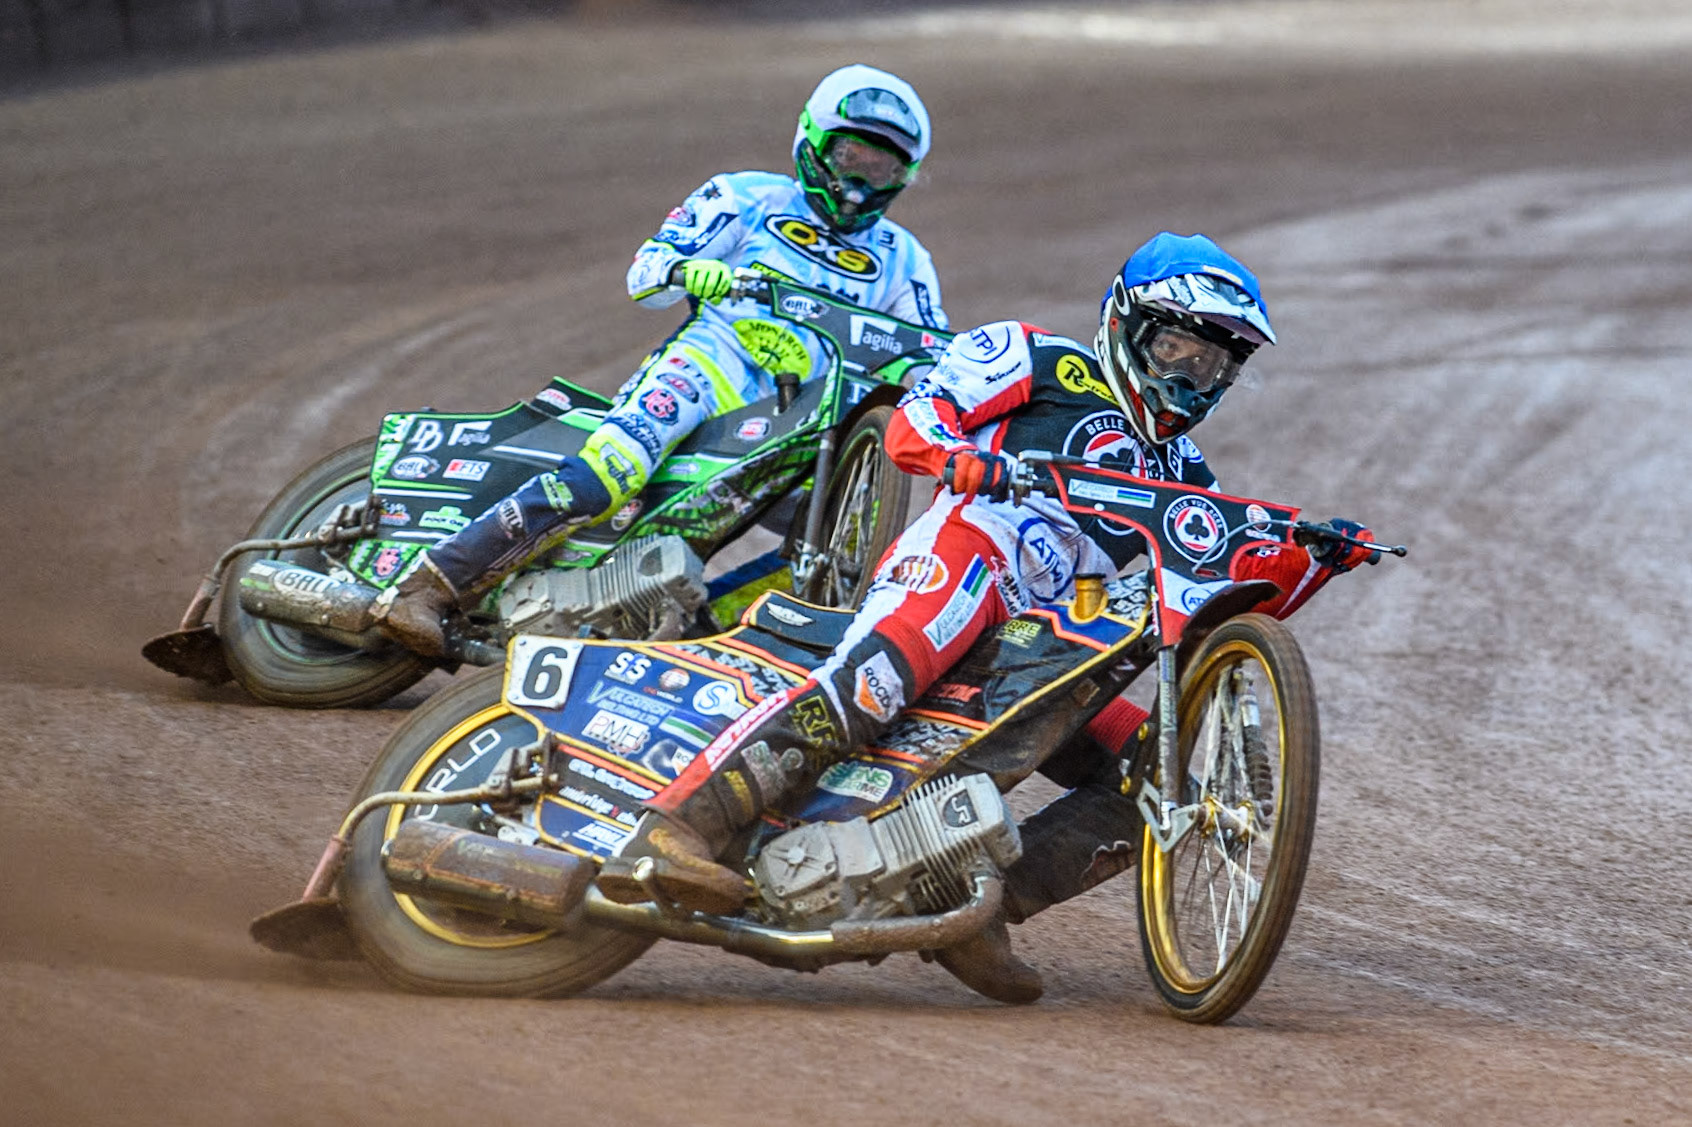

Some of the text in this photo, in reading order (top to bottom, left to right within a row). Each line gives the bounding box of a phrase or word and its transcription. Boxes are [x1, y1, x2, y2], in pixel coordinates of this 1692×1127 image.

[780, 220, 870, 273] OXS
[862, 330, 903, 353] agilia
[1085, 416, 1126, 436] BELLE
[522, 645, 569, 701] 6
